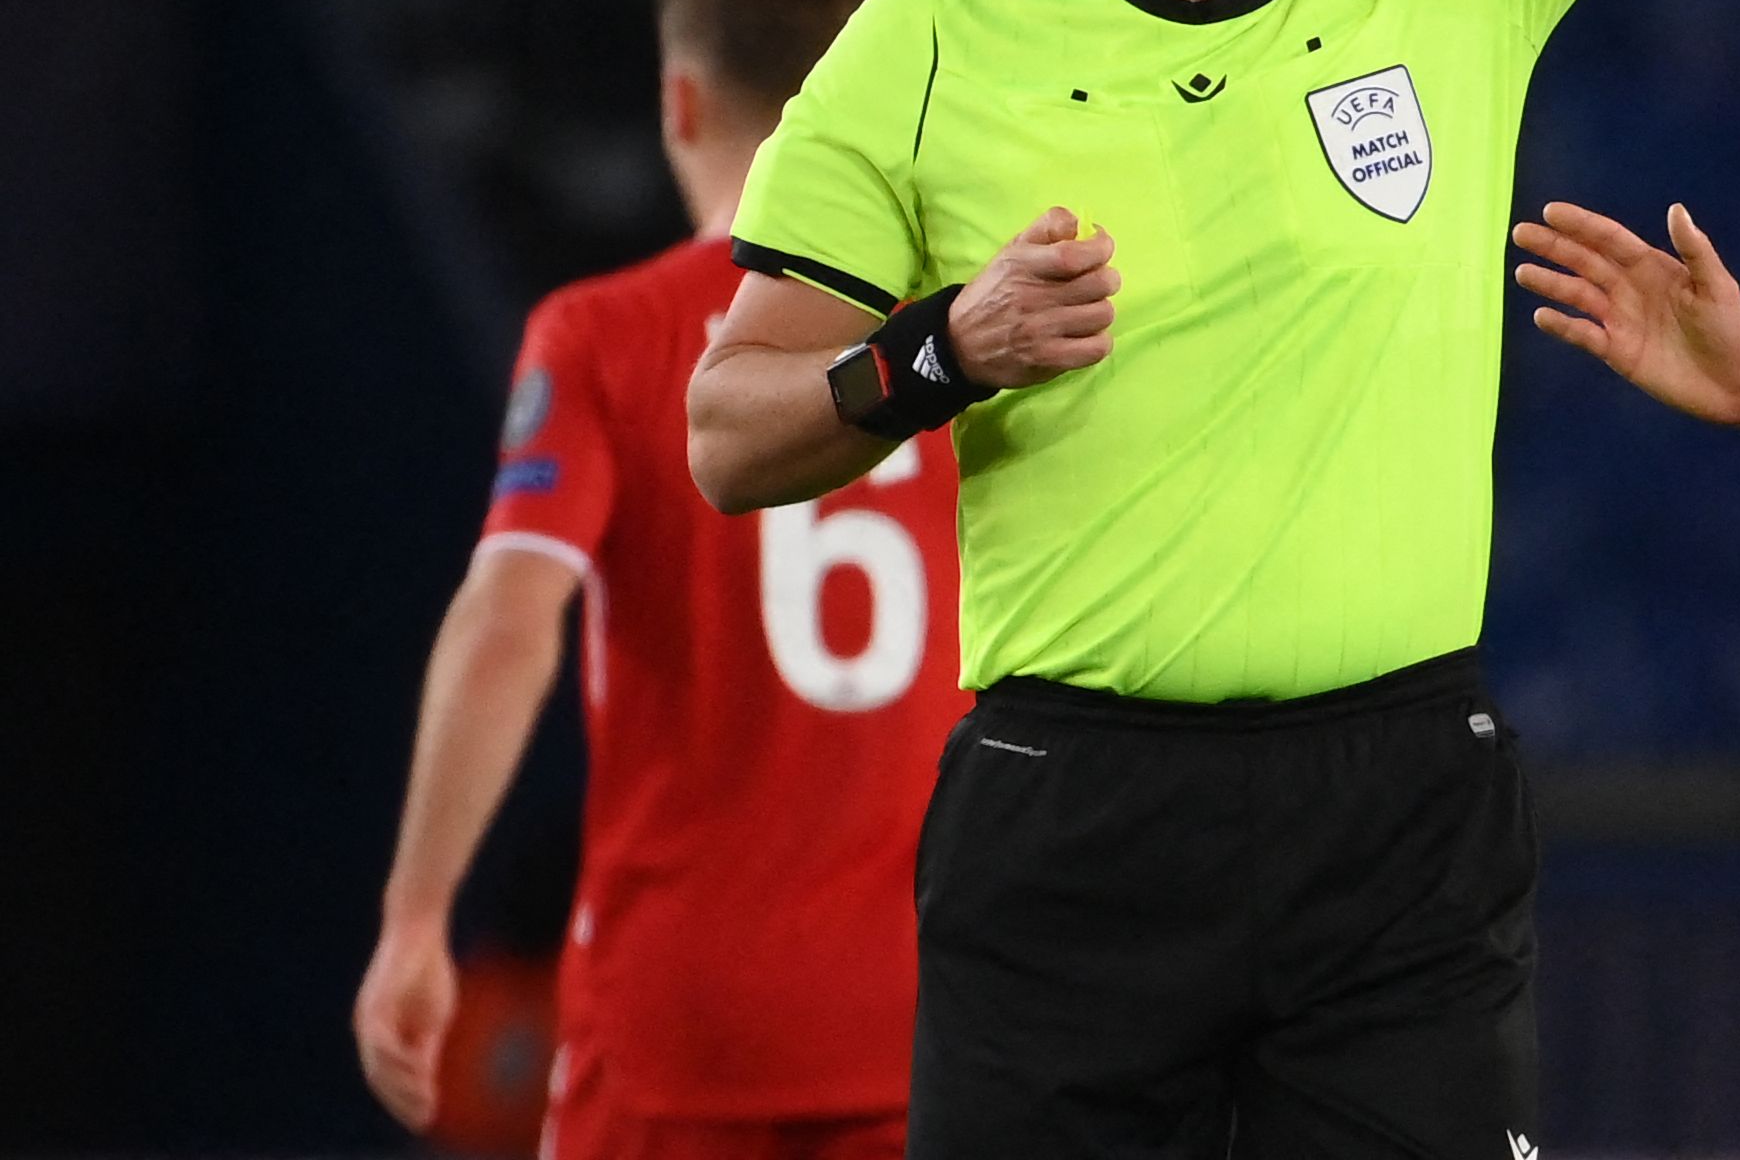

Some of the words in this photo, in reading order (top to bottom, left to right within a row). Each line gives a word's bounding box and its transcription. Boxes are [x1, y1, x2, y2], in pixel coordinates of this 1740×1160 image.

[1336, 93, 1395, 125] UEFA
[1352, 130, 1409, 160] MATCH
[1352, 150, 1423, 183] OFFICIAL
[759, 437, 929, 714] 6
